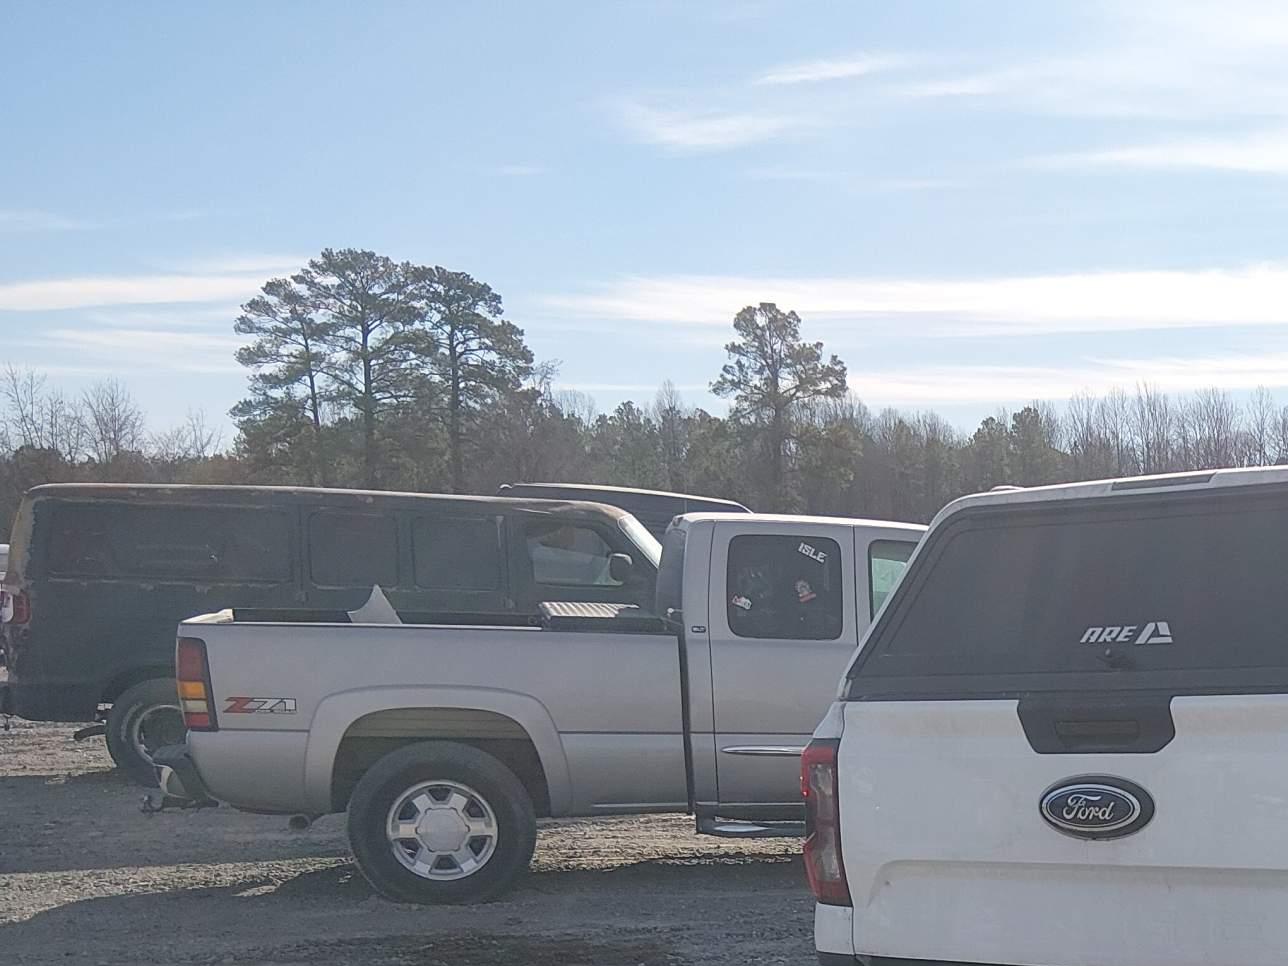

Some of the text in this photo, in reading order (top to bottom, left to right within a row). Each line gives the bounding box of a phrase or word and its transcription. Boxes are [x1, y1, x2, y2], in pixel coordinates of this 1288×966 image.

[798, 542, 827, 563] ISLE
[1081, 626, 1137, 643] ARE
[223, 697, 297, 712] Z71
[1063, 795, 1114, 820] Ford
